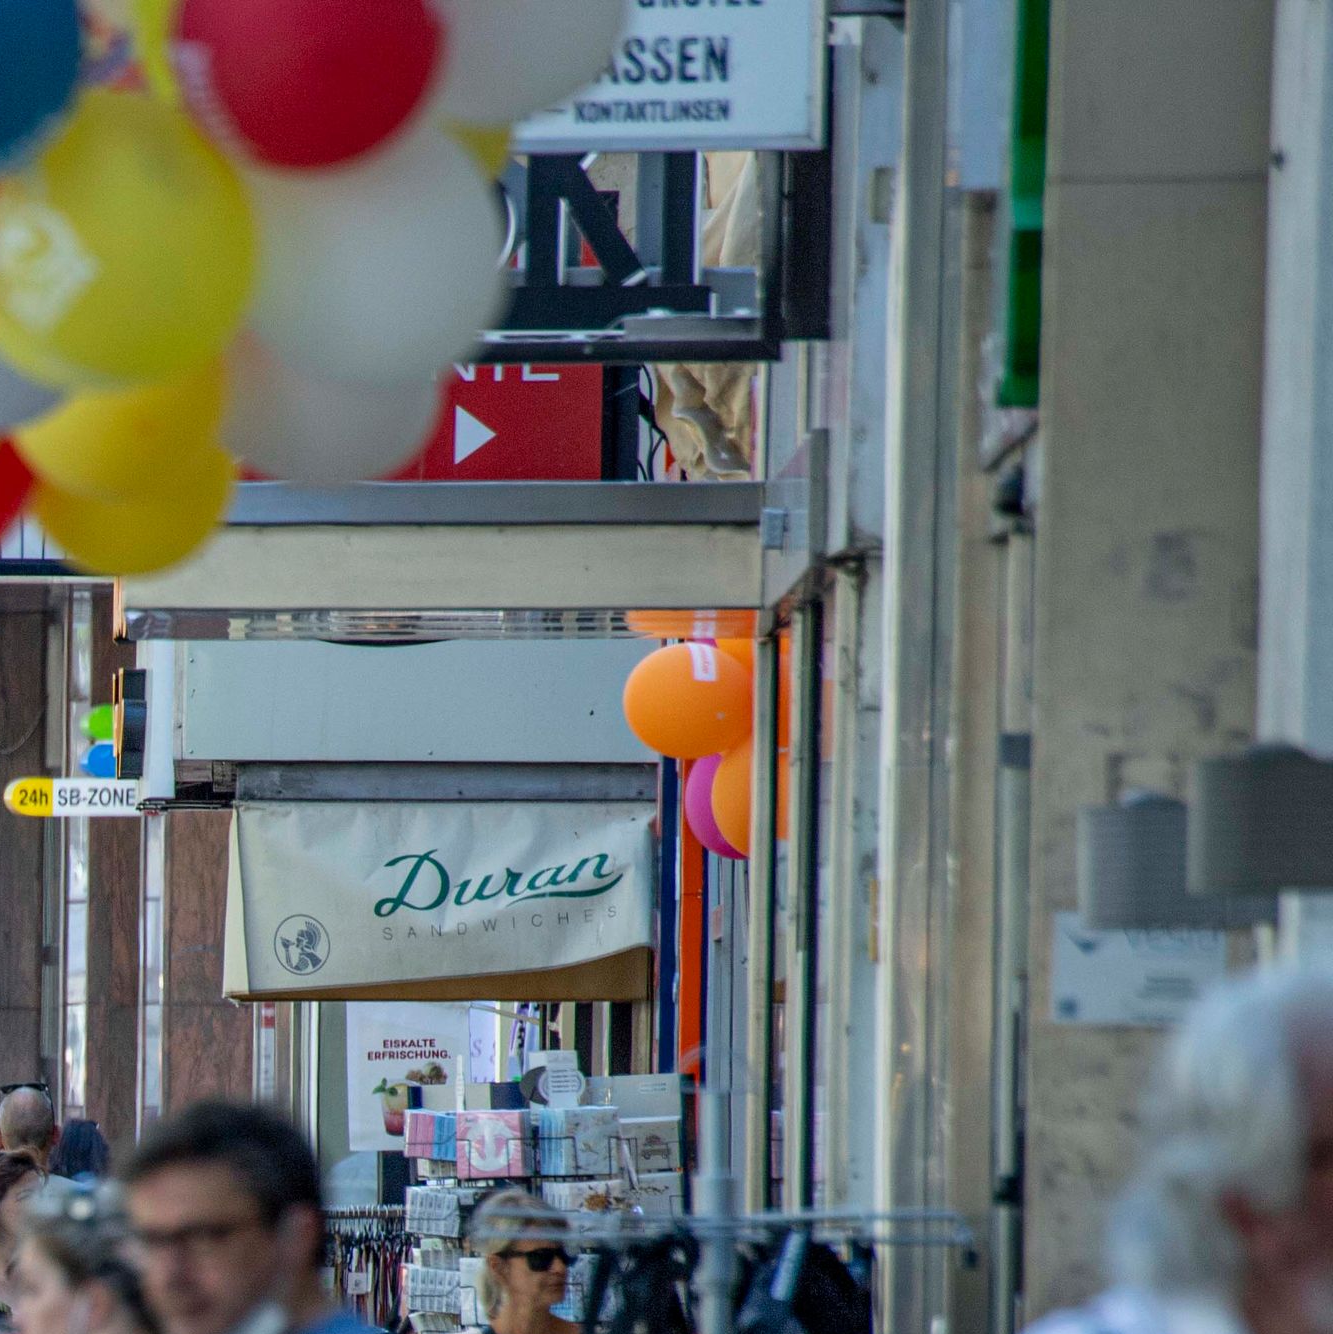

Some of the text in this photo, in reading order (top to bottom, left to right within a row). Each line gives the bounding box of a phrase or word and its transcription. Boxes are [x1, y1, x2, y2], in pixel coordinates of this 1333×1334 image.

[599, 36, 730, 84] ASSEN
[573, 98, 730, 123] KONTAKTLINSEN
[18, 787, 136, 807] 24h SB-ZONE
[374, 849, 623, 917] Duran
[382, 905, 618, 941] SANDWICHES
[367, 1049, 452, 1061] ERFRISCHUNG.
[382, 1038, 436, 1049] EISKALTE
